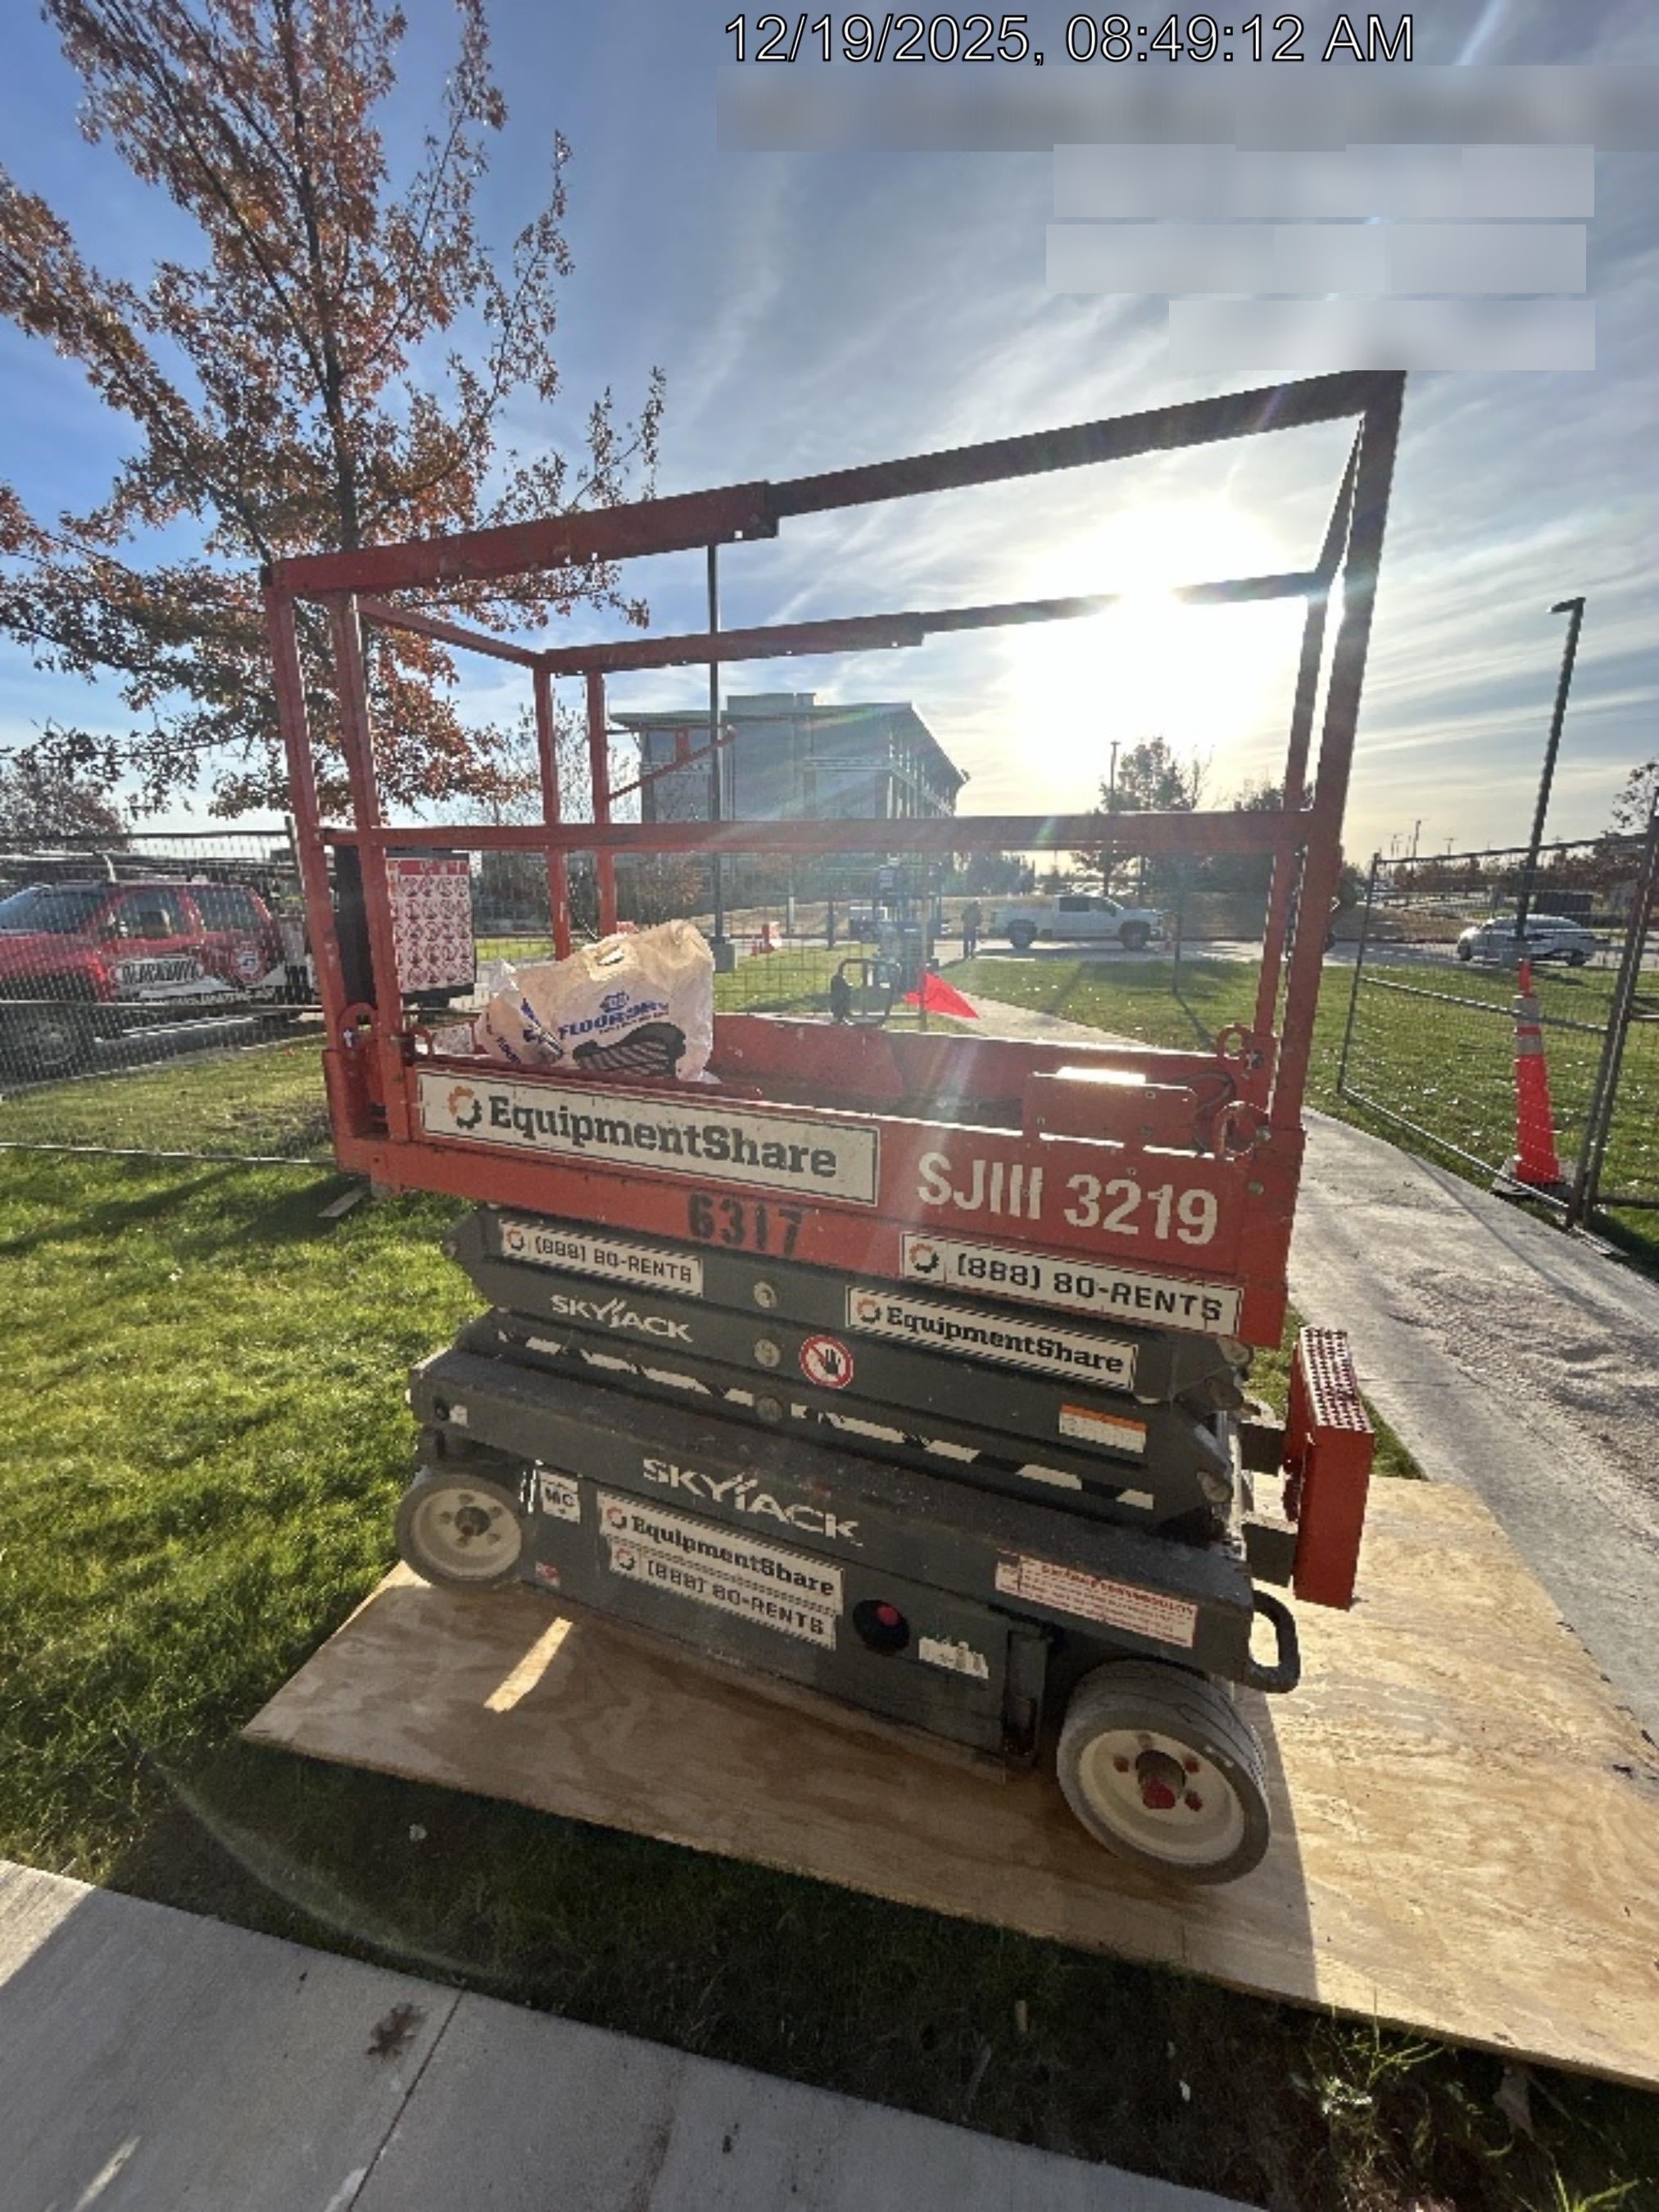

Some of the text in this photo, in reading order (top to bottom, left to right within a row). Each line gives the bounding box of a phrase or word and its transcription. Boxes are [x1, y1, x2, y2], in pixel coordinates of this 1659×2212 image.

[488, 1095, 836, 1178] EquipmentShare
[687, 1191, 807, 1257] 6317
[1064, 1173, 1218, 1246] 3219
[551, 1293, 694, 1344] SKYJACK
[957, 1253, 1223, 1322] (888) 80-RENTS
[886, 1303, 1124, 1375] EquipmentShare
[642, 1458, 864, 1548] SKYJACK
[630, 1514, 834, 1597] EquipmentShare
